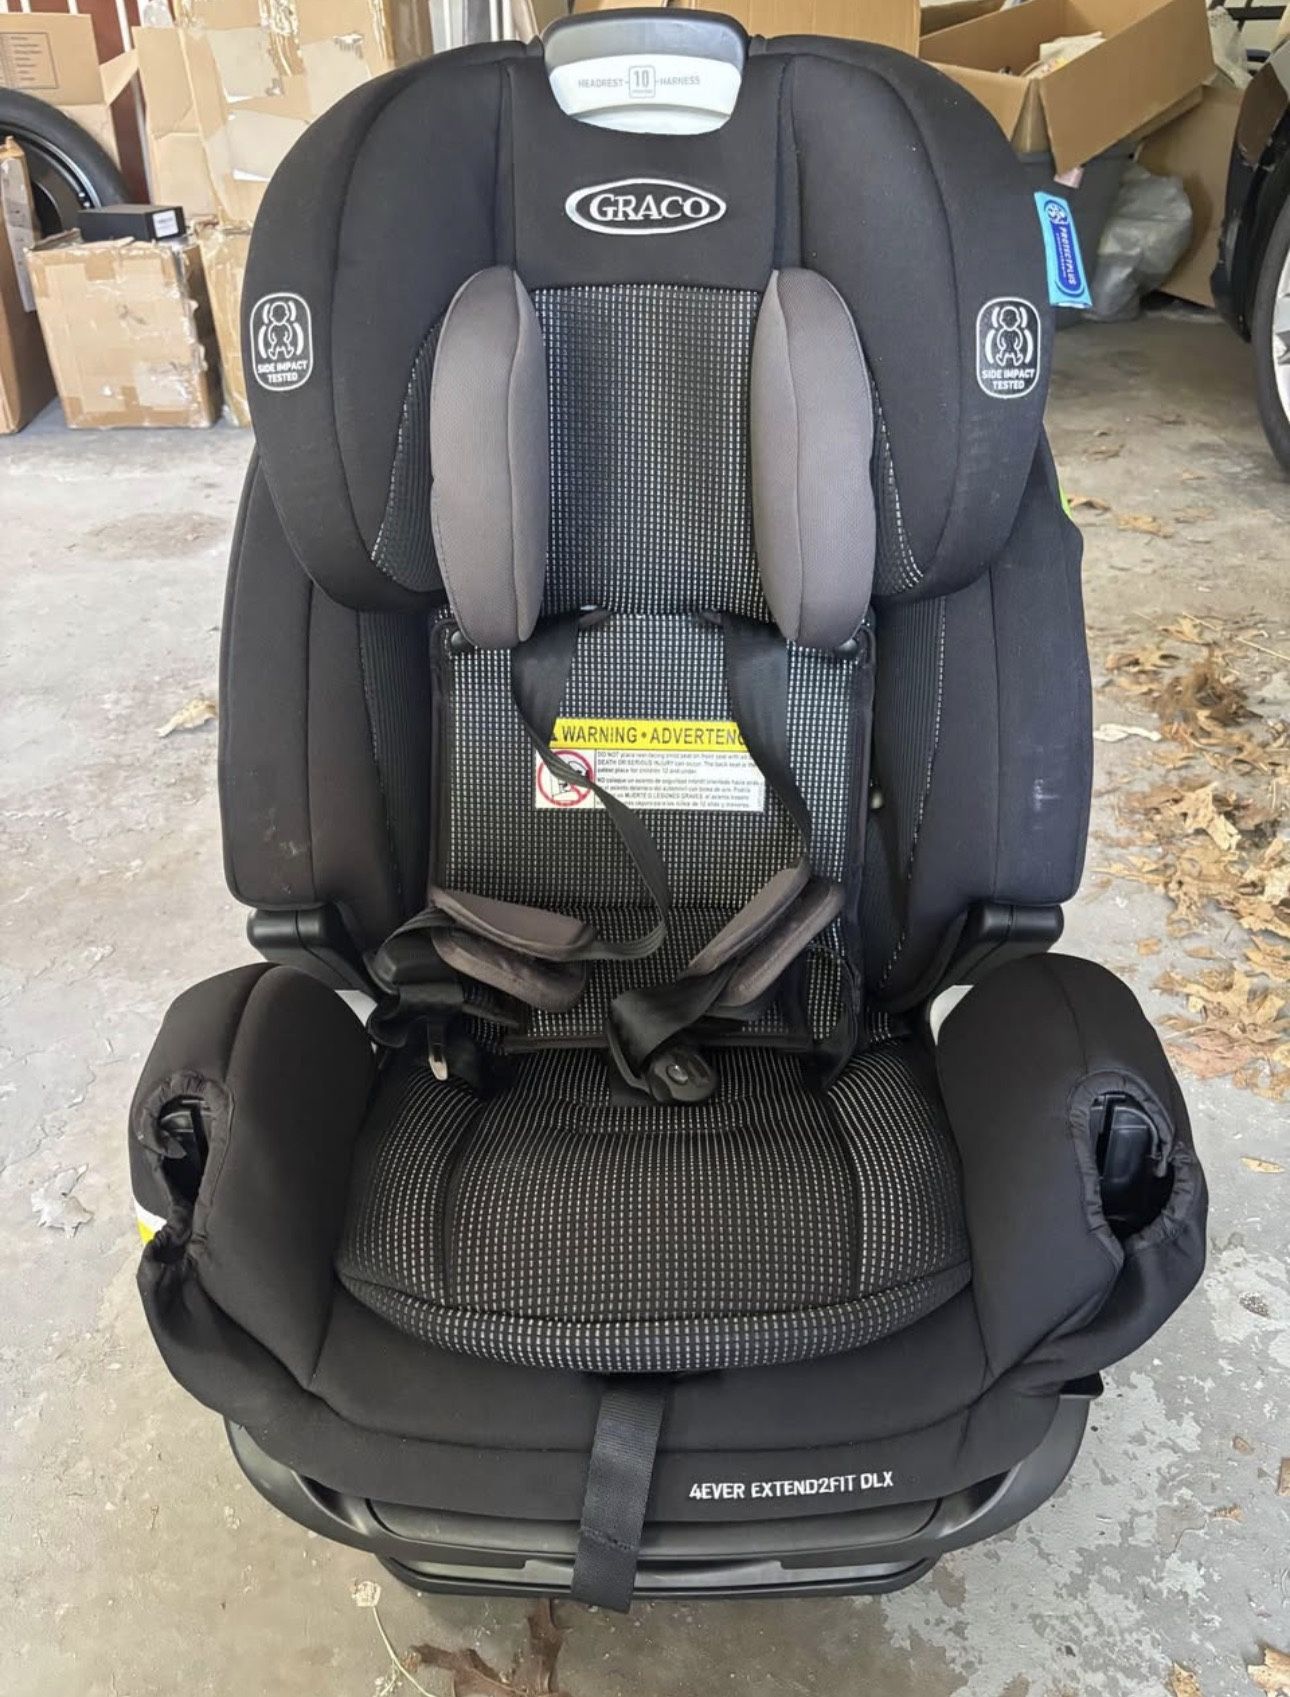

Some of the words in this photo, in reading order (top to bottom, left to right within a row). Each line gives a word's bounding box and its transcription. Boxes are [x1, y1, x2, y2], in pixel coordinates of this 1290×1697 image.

[578, 78, 624, 89] HEADREST
[634, 70, 649, 88] 10
[660, 76, 701, 86] HARNESS
[589, 193, 710, 221] GRACO
[257, 362, 275, 374] SIDE
[276, 360, 308, 372] IMPACT
[982, 369, 1002, 379] SIDE
[1003, 368, 1035, 379] IMPACT
[267, 372, 298, 383] TESTED
[993, 380, 1025, 390] TESTED
[561, 725, 638, 744] WARNING
[689, 1482, 745, 1500] 4EVER
[751, 1475, 856, 1498] EXTEND2FIT
[860, 1471, 894, 1490] DLX
